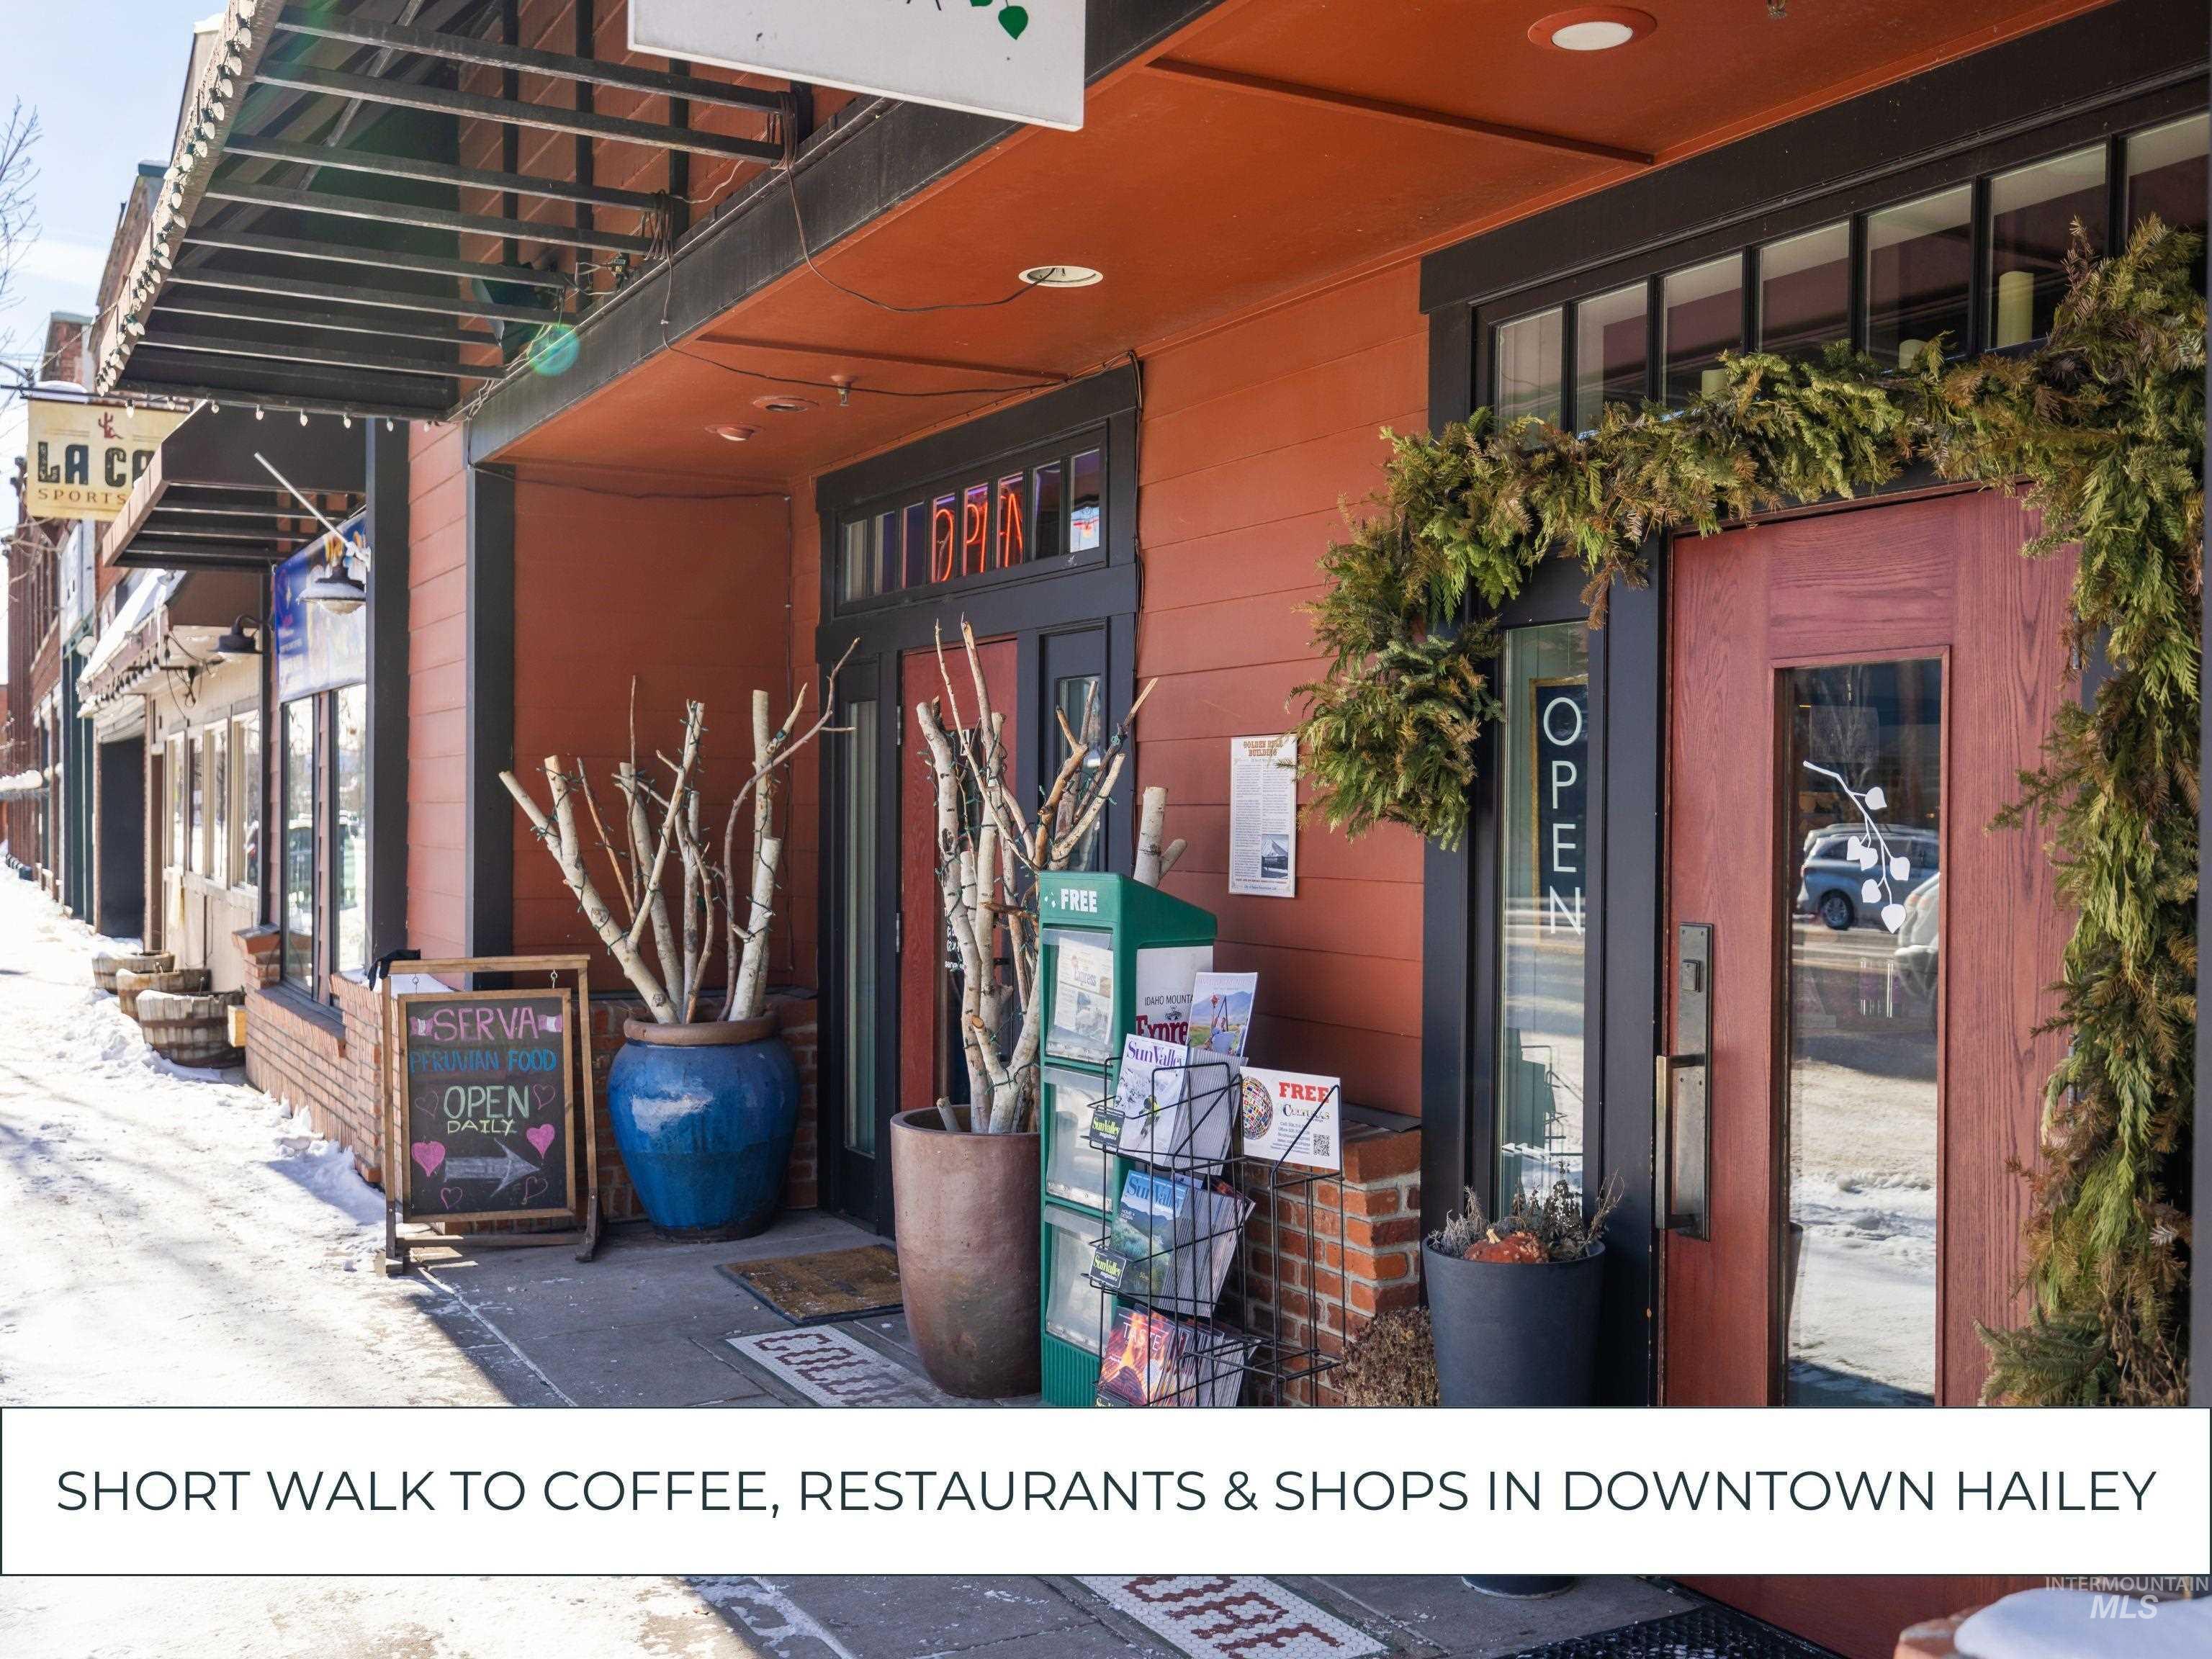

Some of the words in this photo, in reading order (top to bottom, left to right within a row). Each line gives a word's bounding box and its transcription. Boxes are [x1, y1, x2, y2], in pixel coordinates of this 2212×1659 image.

[38, 441, 89, 485] LA
[38, 487, 127, 505] SPORTS
[1543, 697, 1583, 935] OPEN
[1061, 888, 1097, 912] FREE
[1145, 994, 1164, 1006] IDAHO
[433, 1007, 539, 1042] SERVA
[410, 1048, 500, 1074] PERUVIAN
[508, 1048, 557, 1072] FOOD
[444, 1085, 530, 1119] OPEN
[1279, 1082, 1329, 1103] FREE
[447, 1118, 517, 1136] DAILY
